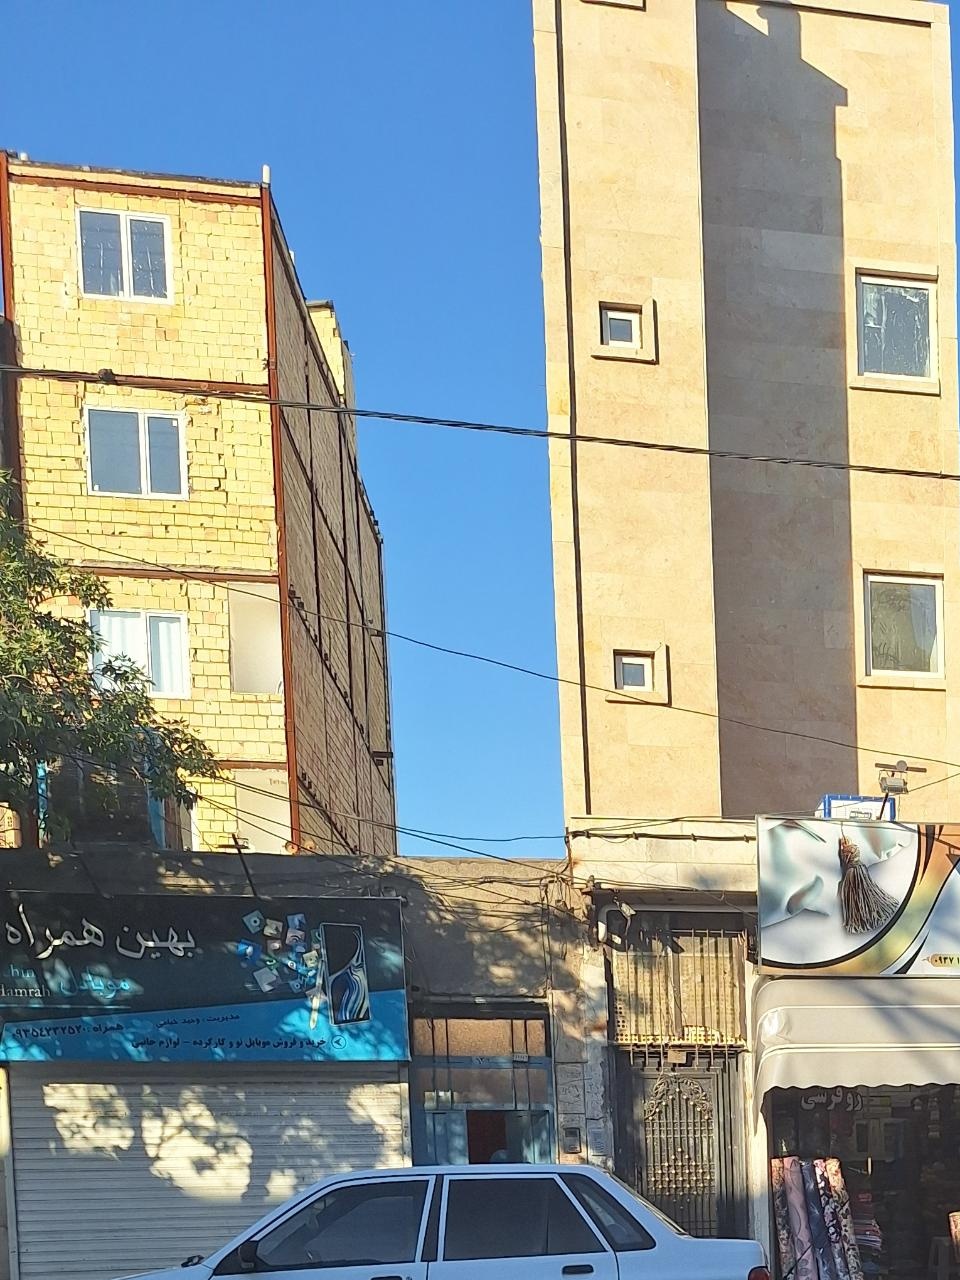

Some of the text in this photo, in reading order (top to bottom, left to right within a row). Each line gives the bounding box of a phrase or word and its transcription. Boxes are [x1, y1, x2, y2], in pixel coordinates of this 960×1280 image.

[5, 903, 195, 959] بهین همراه
[131, 1036, 156, 1049] جانبی
[159, 1037, 181, 1049] لوازم
[245, 1036, 271, 1049] موبایل
[272, 1037, 297, 1049] فروش
[306, 1037, 326, 1049] خرید
